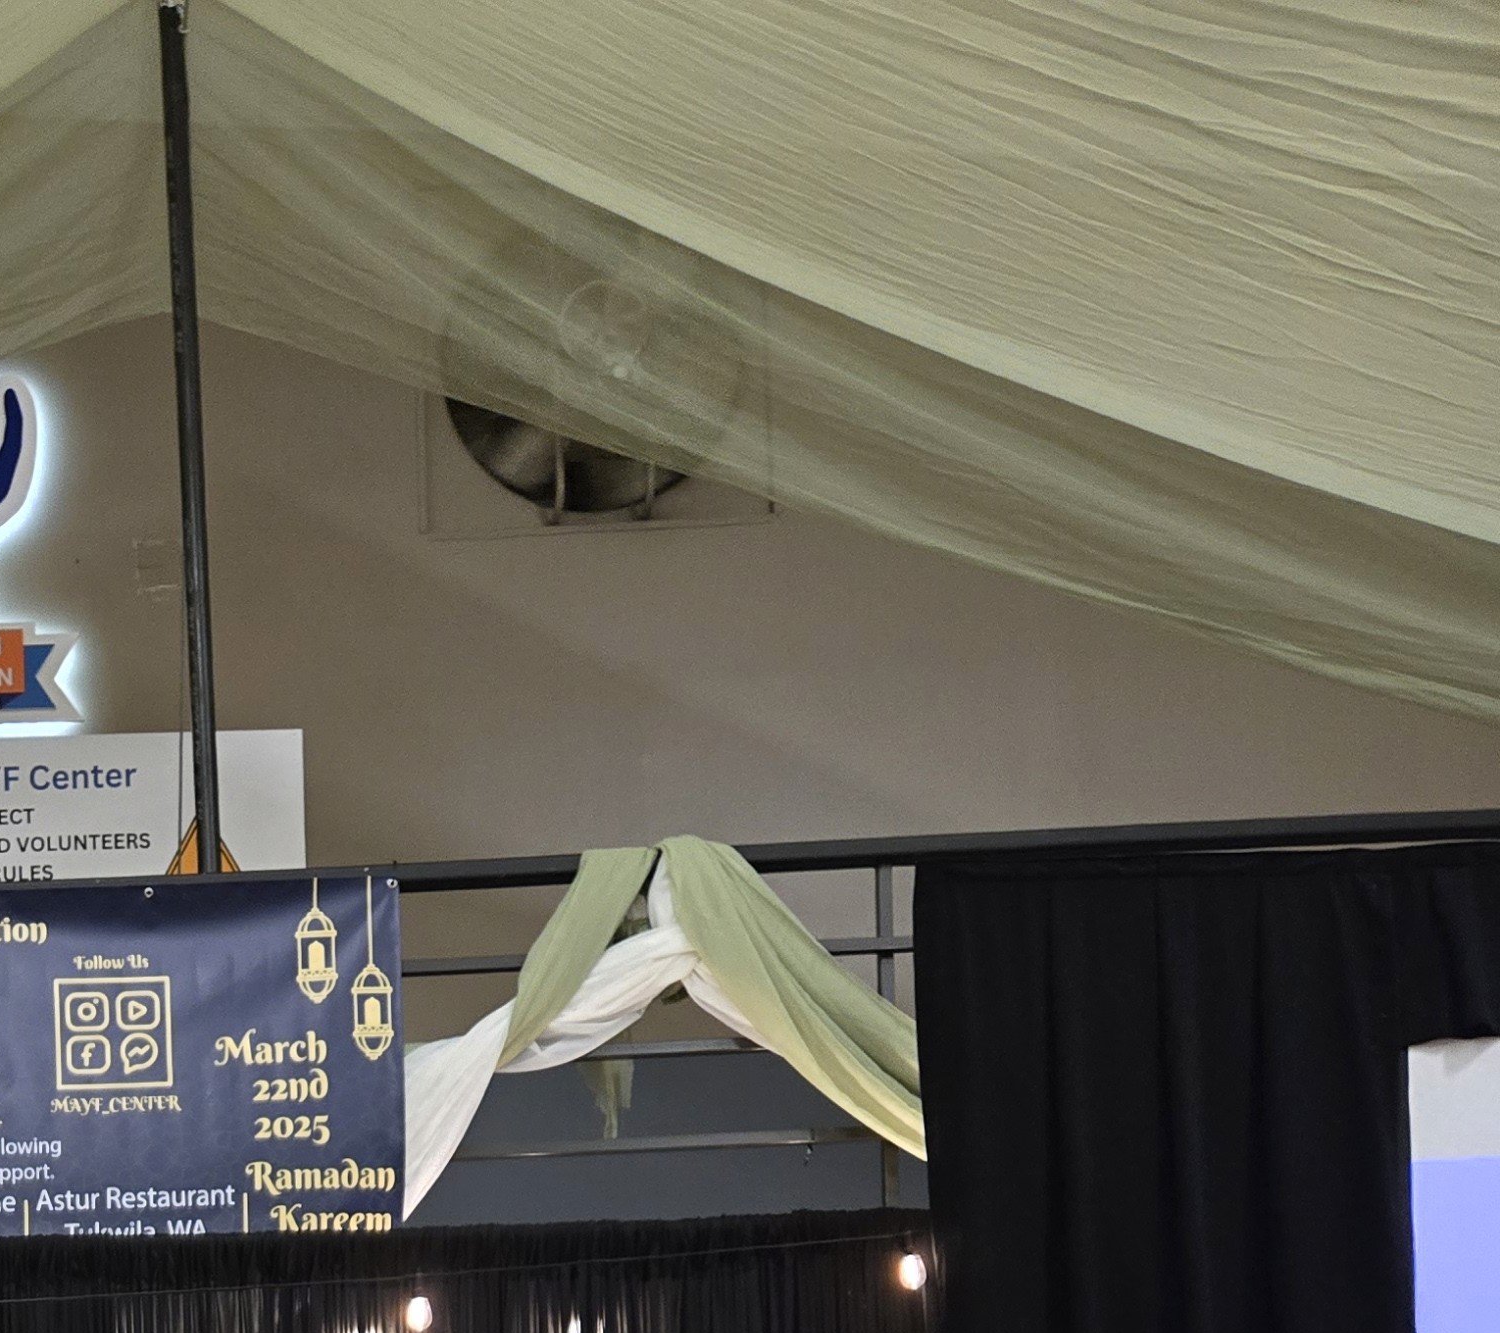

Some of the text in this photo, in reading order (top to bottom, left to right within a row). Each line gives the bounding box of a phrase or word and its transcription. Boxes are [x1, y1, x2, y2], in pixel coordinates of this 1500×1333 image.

[30, 763, 137, 790] Center
[17, 831, 151, 853] VOLUNTEERS
[73, 954, 150, 970] Follow Us
[214, 1028, 327, 1066] March
[253, 1068, 328, 1102] 22nd
[50, 1094, 182, 1115] MAYF_CENTER
[254, 1114, 331, 1145] 2025
[246, 1158, 396, 1196] Ramadan
[36, 1184, 236, 1212] Astur Restaurant
[270, 1202, 392, 1232] Kareem
